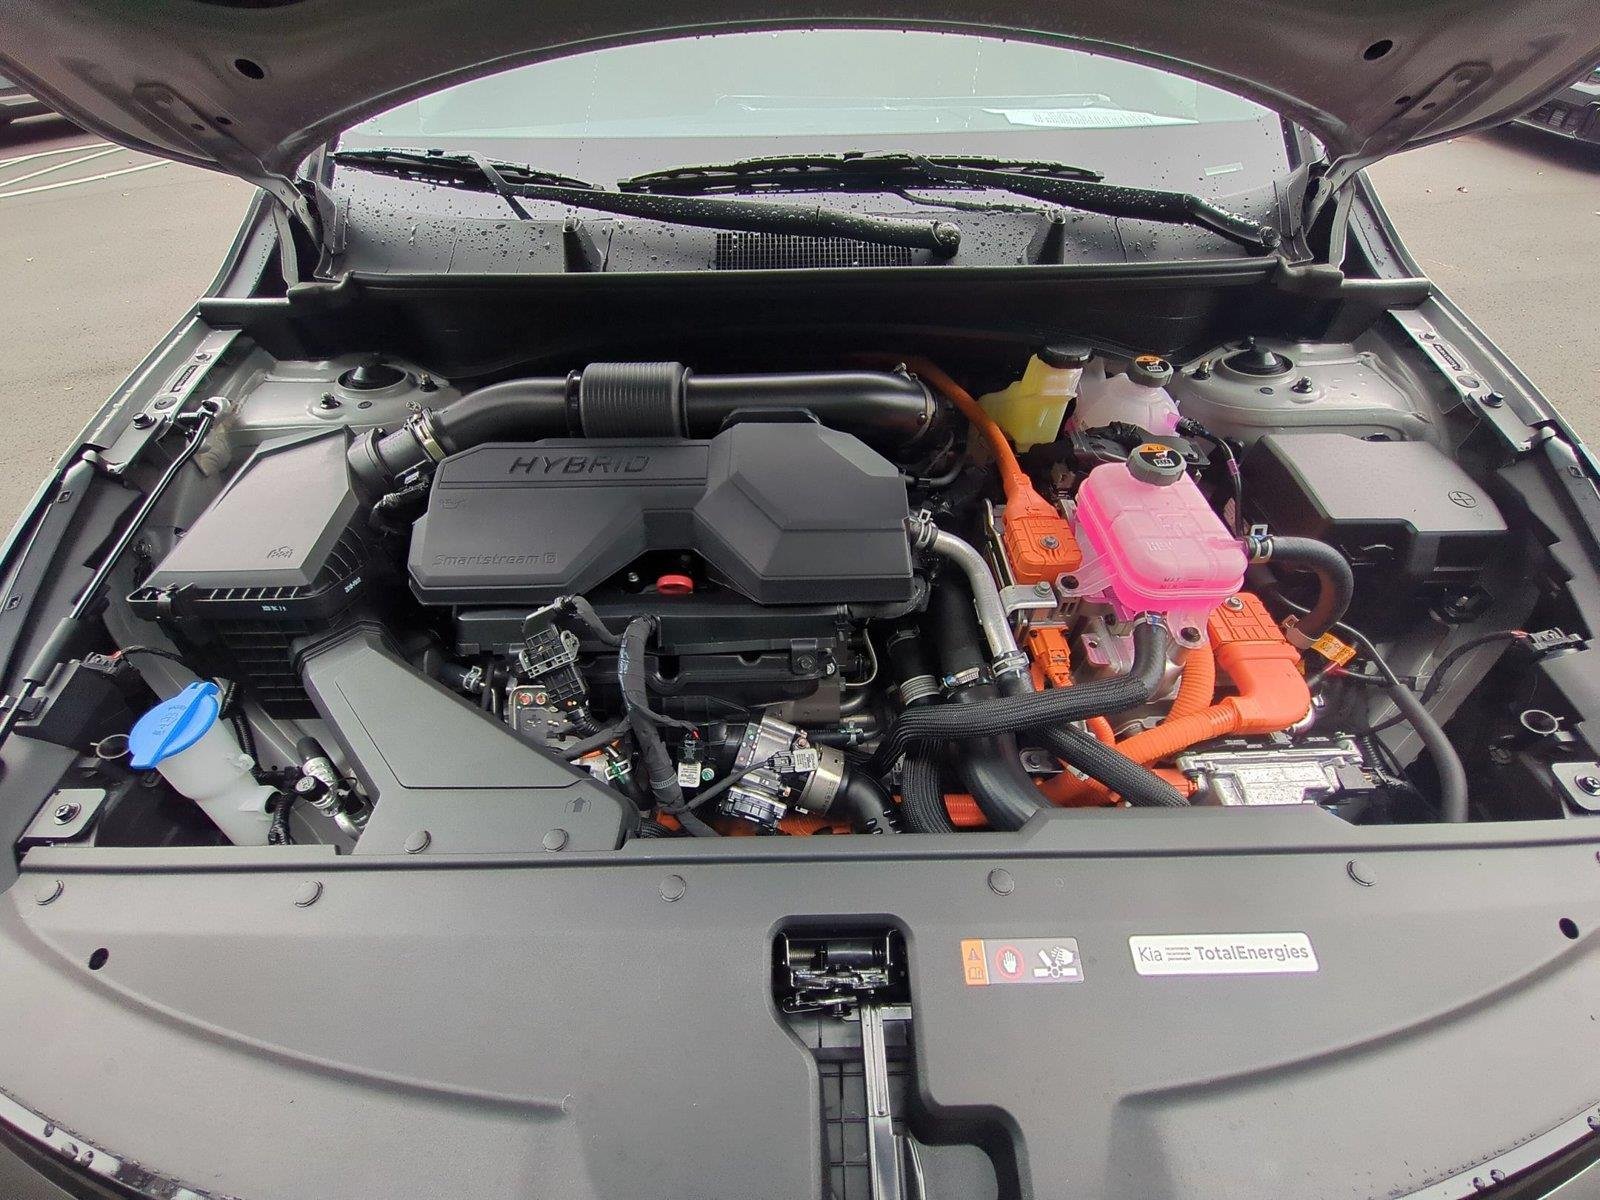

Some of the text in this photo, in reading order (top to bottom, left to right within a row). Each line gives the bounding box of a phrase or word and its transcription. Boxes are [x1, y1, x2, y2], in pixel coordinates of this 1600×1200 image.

[508, 455, 650, 475] HYBRID
[432, 553, 541, 567] Smartstream
[1137, 944, 1309, 962] Kia TotalEnergies
